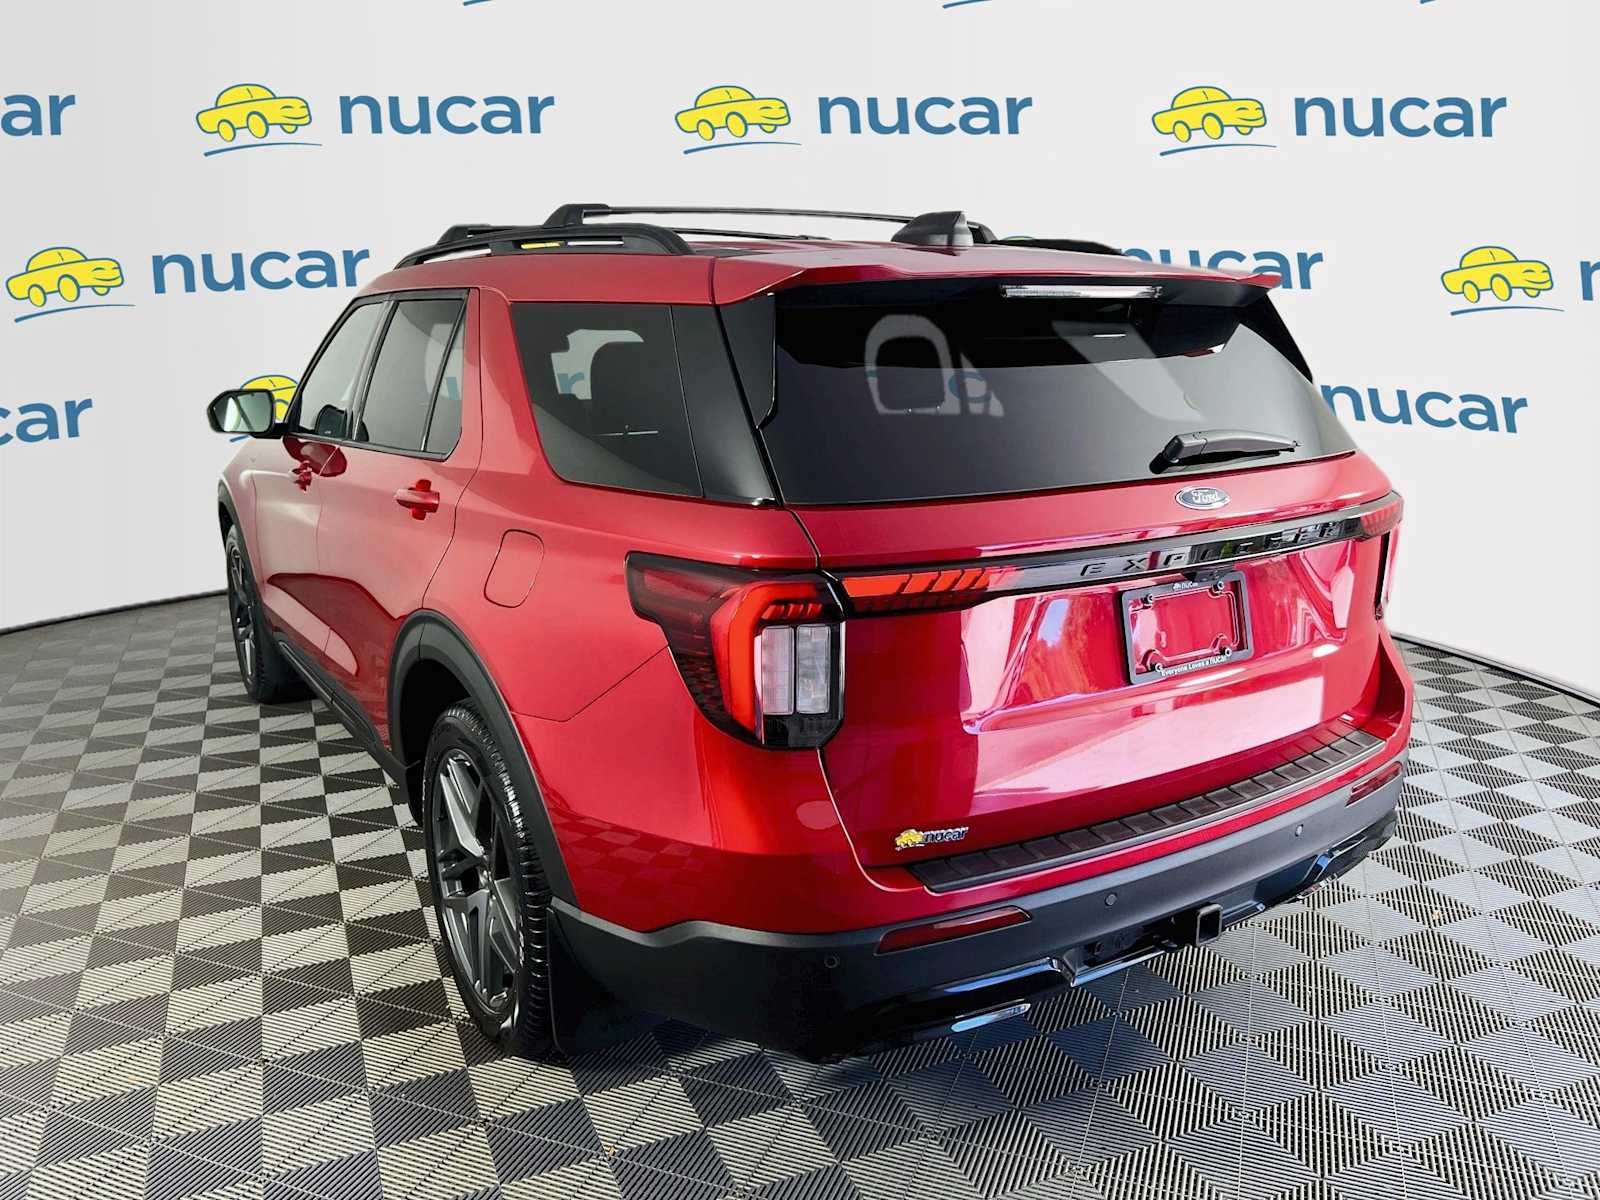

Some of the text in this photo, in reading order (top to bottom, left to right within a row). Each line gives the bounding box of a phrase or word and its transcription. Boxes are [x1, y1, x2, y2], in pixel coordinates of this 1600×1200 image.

[340, 96, 554, 134] nucar
[819, 97, 1032, 134] nucar
[1295, 97, 1506, 137] nucar
[152, 250, 369, 294] nucar
[1320, 384, 1528, 433] nucar
[1191, 490, 1217, 503] Ford
[1161, 665, 1188, 677] Everyone
[1188, 660, 1205, 670] Loves
[923, 827, 969, 843] nucar
